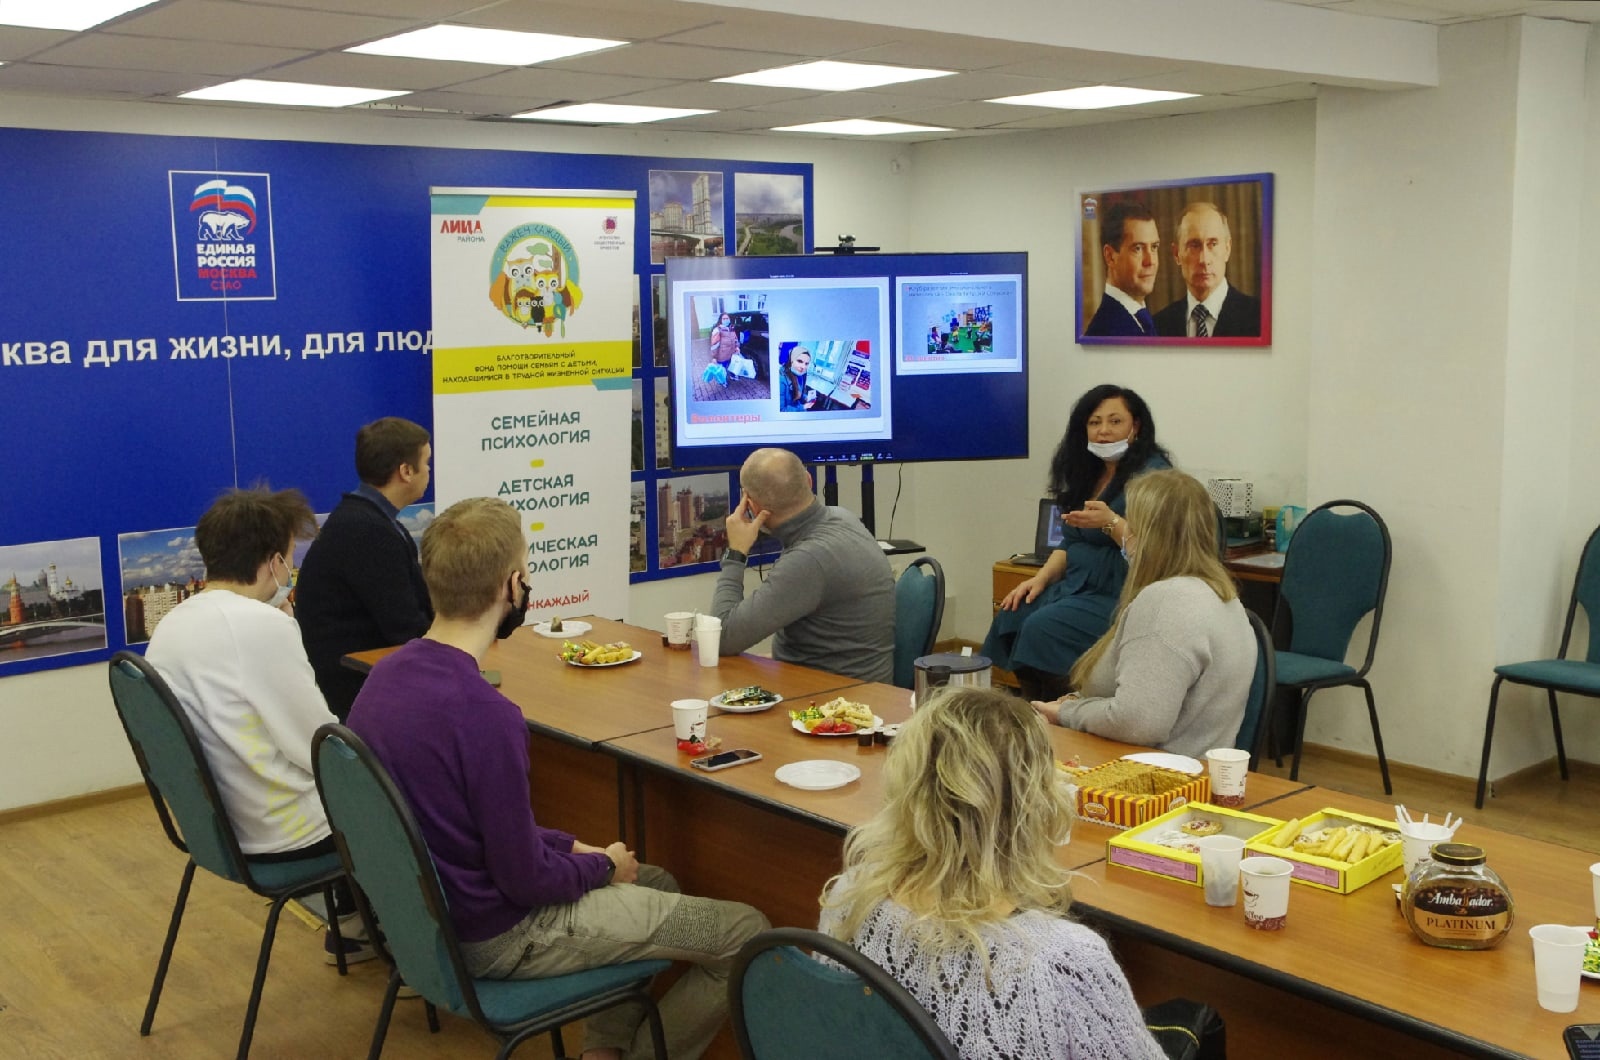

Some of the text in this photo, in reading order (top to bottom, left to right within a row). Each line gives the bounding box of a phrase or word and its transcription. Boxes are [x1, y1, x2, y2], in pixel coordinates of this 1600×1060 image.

[440, 219, 482, 235] ЛИЦА
[457, 235, 485, 243] РАЙОНА
[196, 243, 256, 256] ЕДИНАЯ
[197, 255, 256, 268] РОССИЯ
[198, 268, 257, 278] МОСКВА
[2, 340, 72, 366] ква
[83, 338, 158, 368] для
[168, 335, 292, 361] жизни,
[301, 331, 365, 360] для
[496, 350, 576, 362] БЛАГОТВОРИТЕЛЬНЫЙ
[491, 410, 580, 430] СЕМЕЙНАЯ
[481, 429, 590, 451] ПСИХОЛОГИЯ
[498, 474, 574, 496] ДЕТСКАЯ
[1427, 917, 1495, 930] PLATINUM
